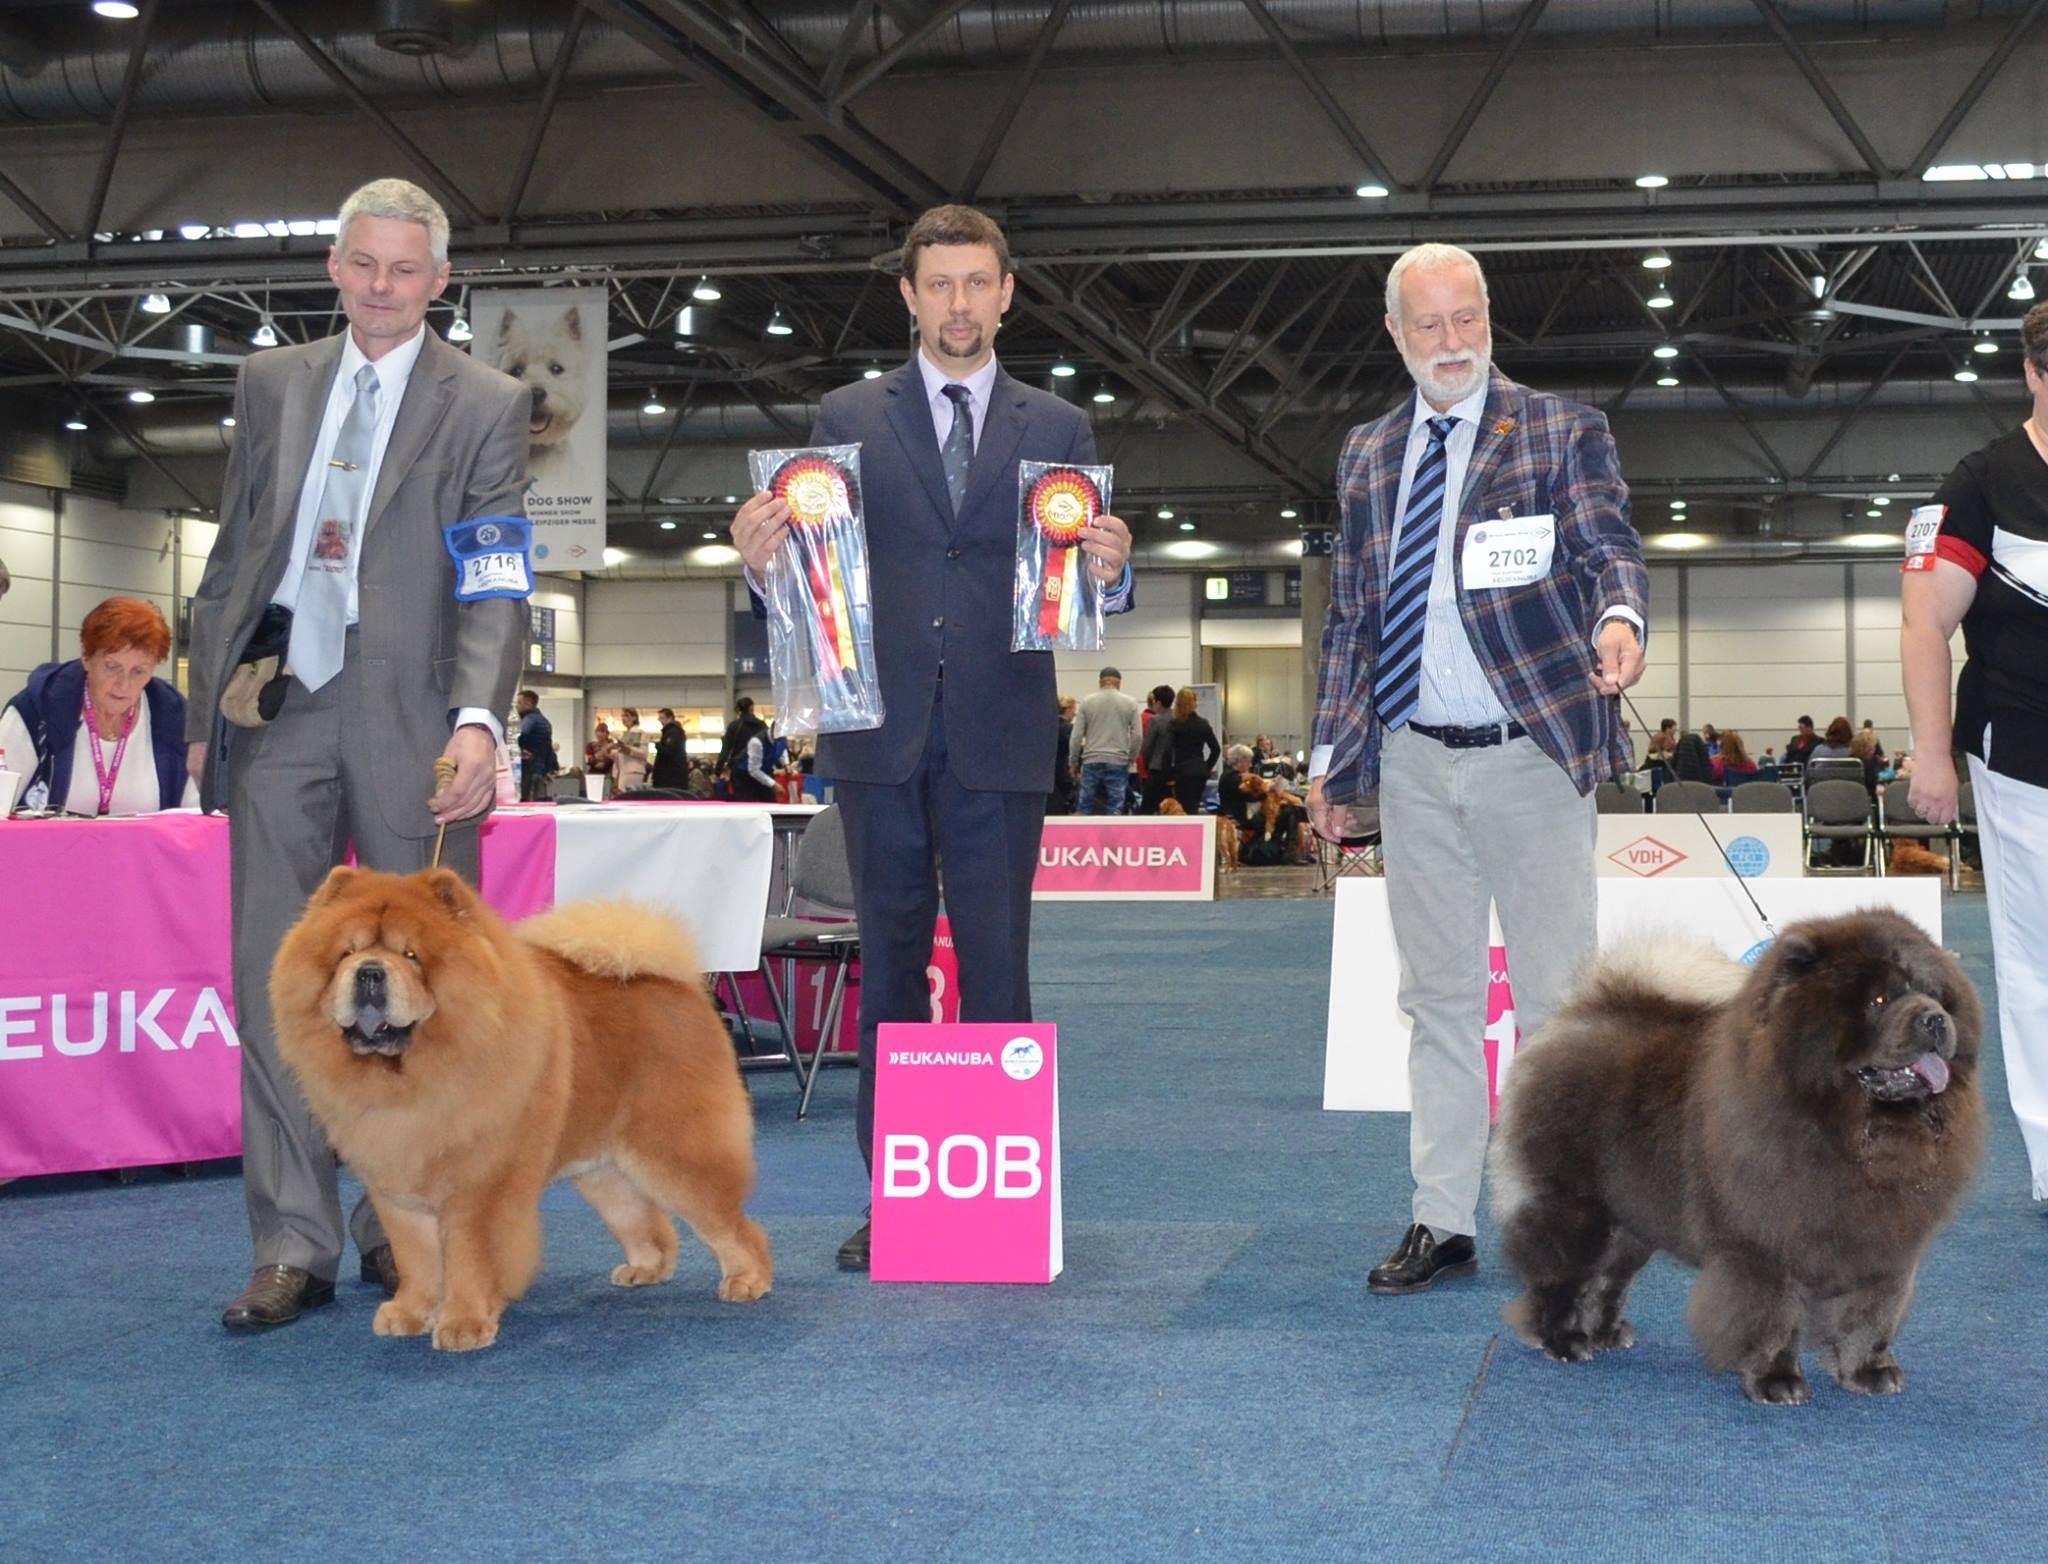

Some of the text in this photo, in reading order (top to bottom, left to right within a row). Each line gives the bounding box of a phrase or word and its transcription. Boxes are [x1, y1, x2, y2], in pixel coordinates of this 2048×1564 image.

[527, 496, 593, 506] DOG SHOW
[1911, 523, 1937, 538] 2707
[1488, 548, 1538, 568] 2702
[1040, 847, 1188, 866] UKANUBA
[1628, 850, 1664, 864] VDH
[0, 987, 240, 1060] EUKA
[899, 1052, 994, 1065] EUKANUBA
[883, 1134, 1042, 1199] BOB
